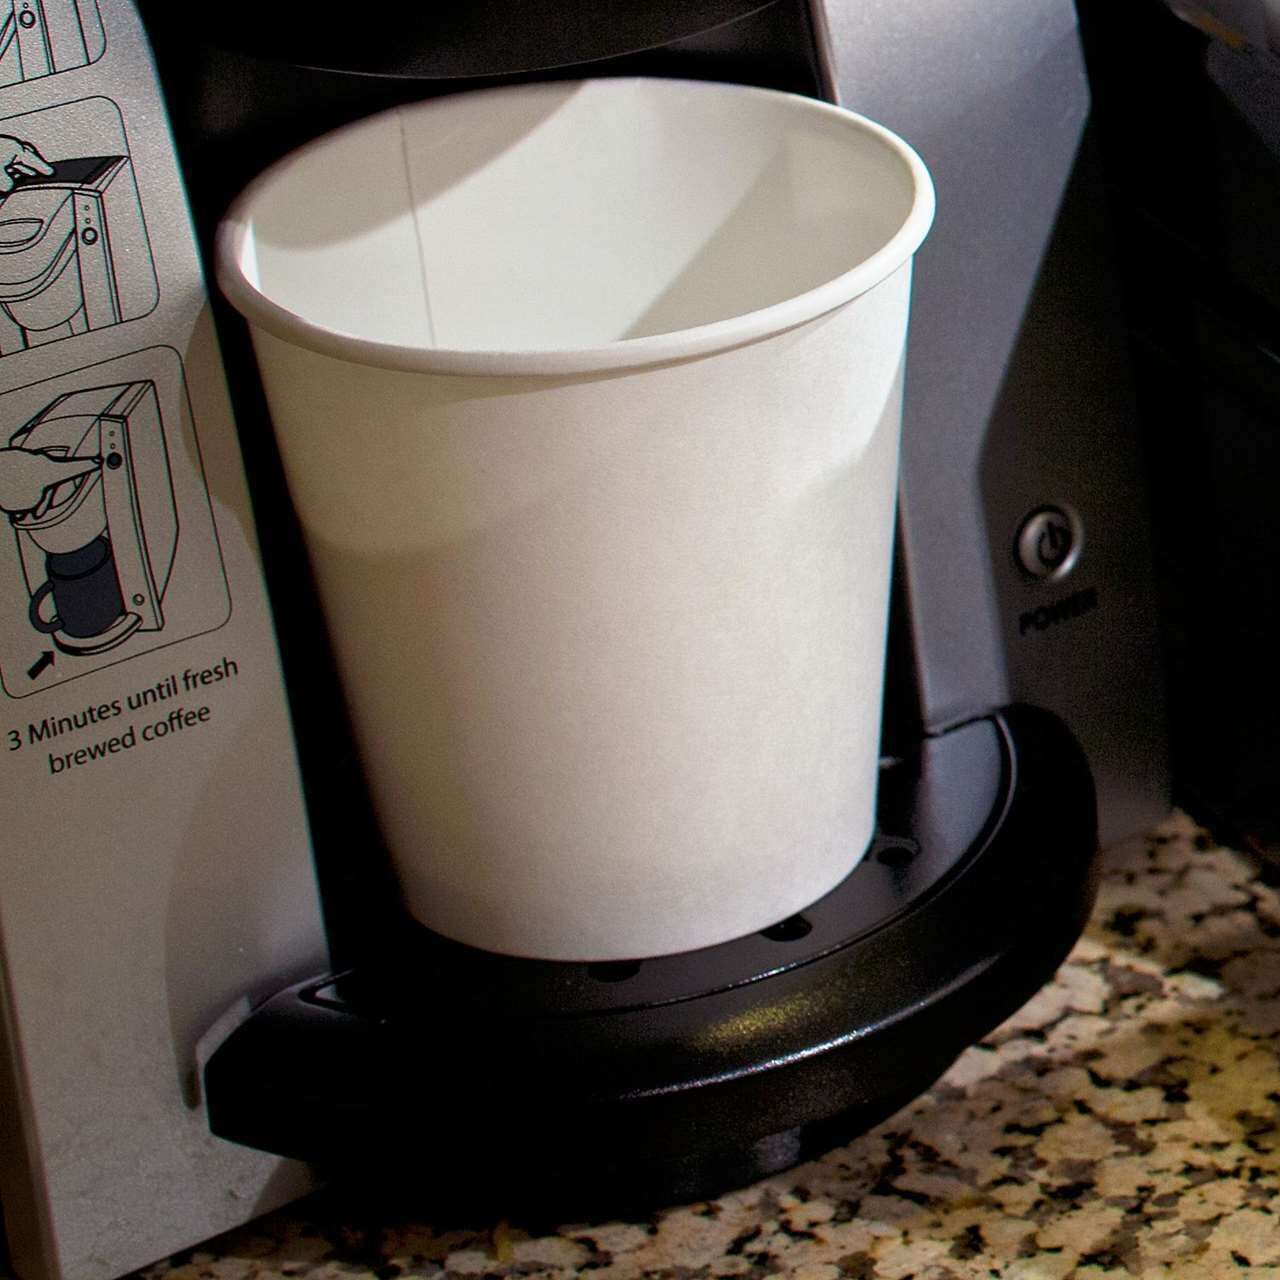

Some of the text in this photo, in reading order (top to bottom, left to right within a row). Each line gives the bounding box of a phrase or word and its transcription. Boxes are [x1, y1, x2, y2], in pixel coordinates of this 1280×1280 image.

[7, 655, 240, 752] 3 Minutes until fresh
[48, 704, 212, 774] brewed coffee
